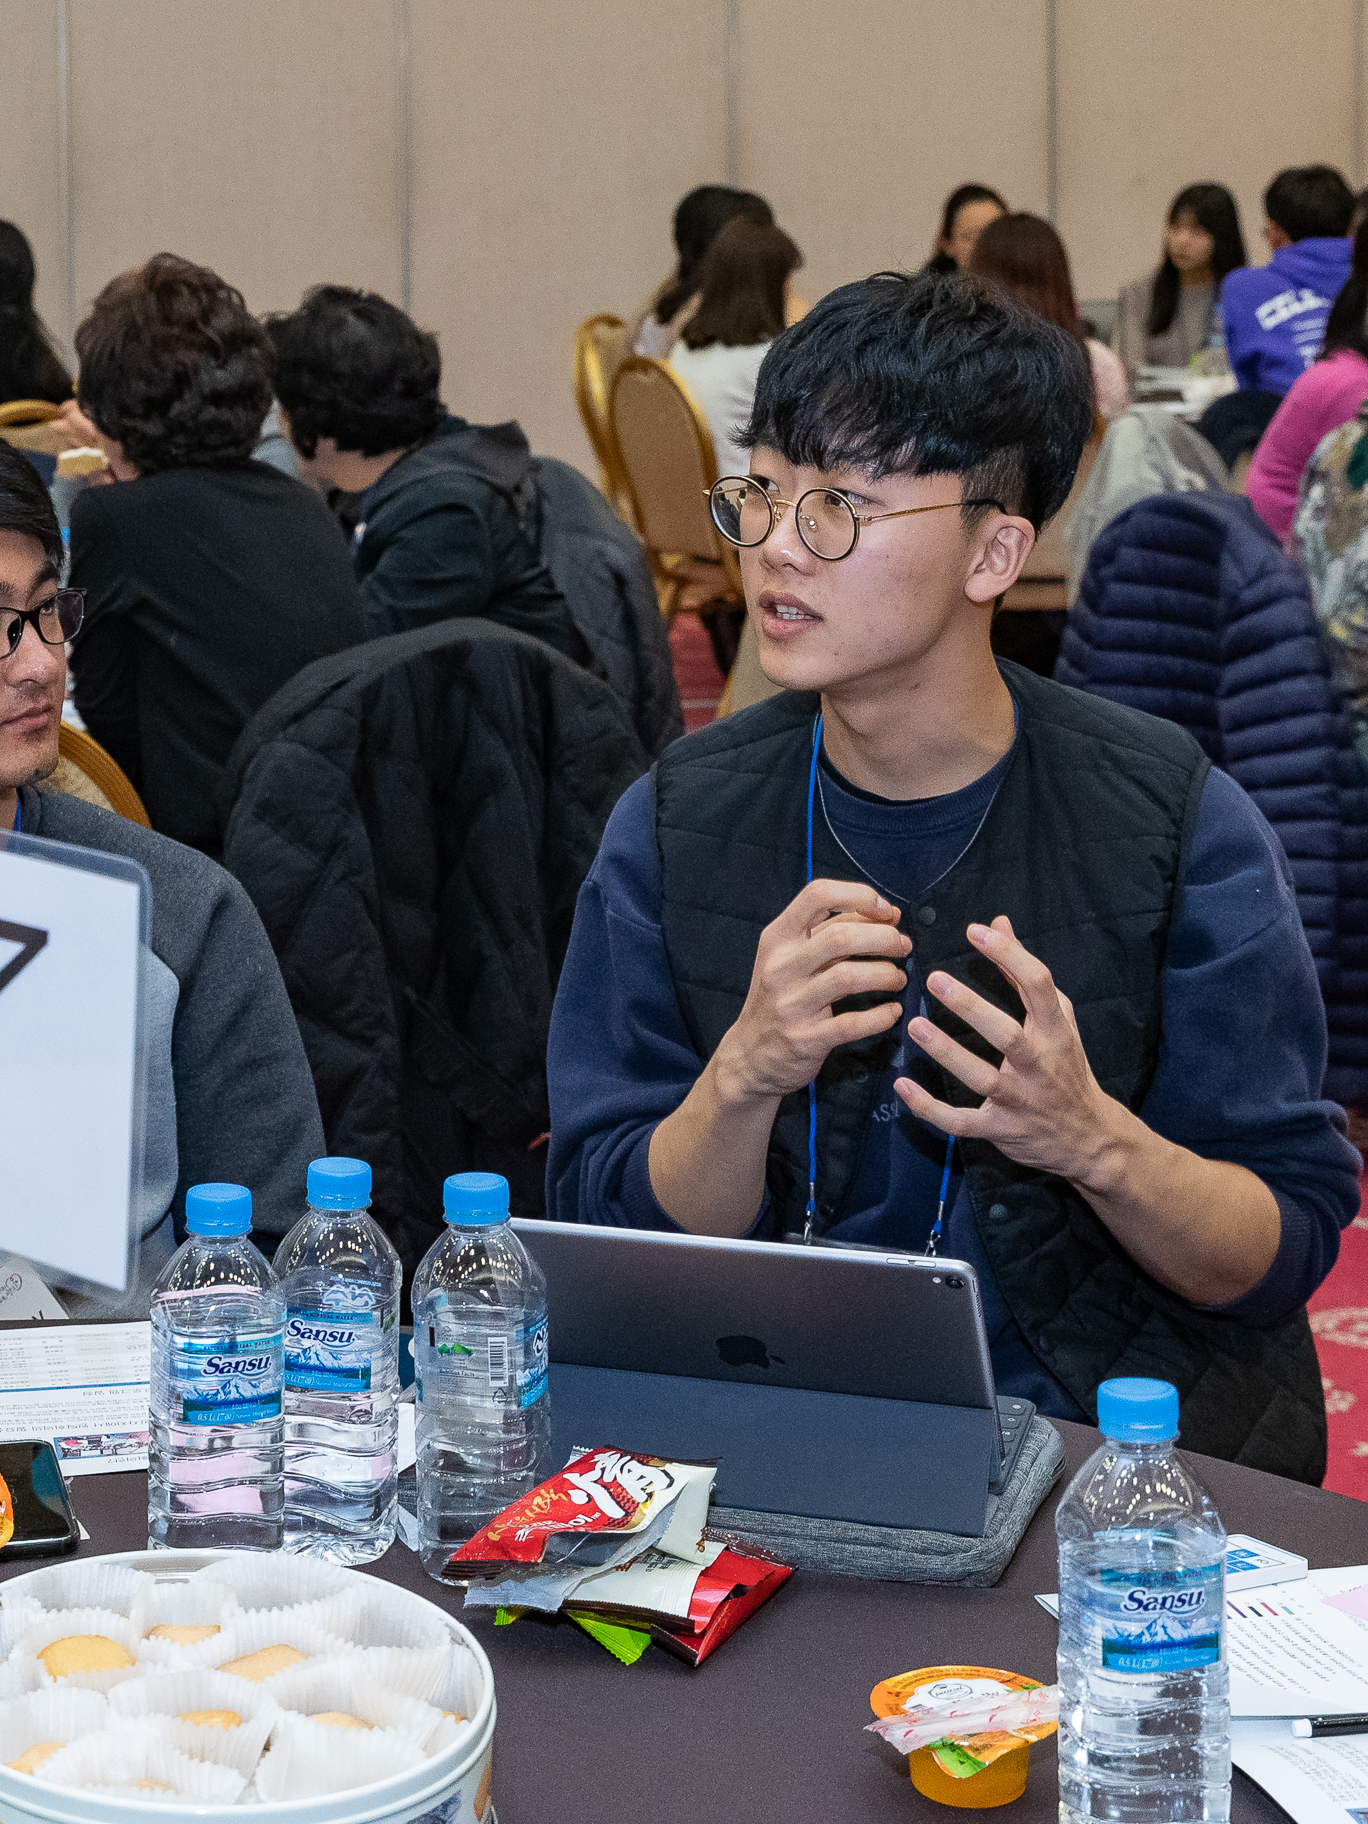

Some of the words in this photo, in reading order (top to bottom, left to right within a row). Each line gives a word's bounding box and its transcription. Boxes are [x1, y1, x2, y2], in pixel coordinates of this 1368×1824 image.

[287, 1320, 355, 1343] Sansu
[203, 1356, 271, 1375] Sansu
[1123, 1589, 1205, 1612] Sansu
